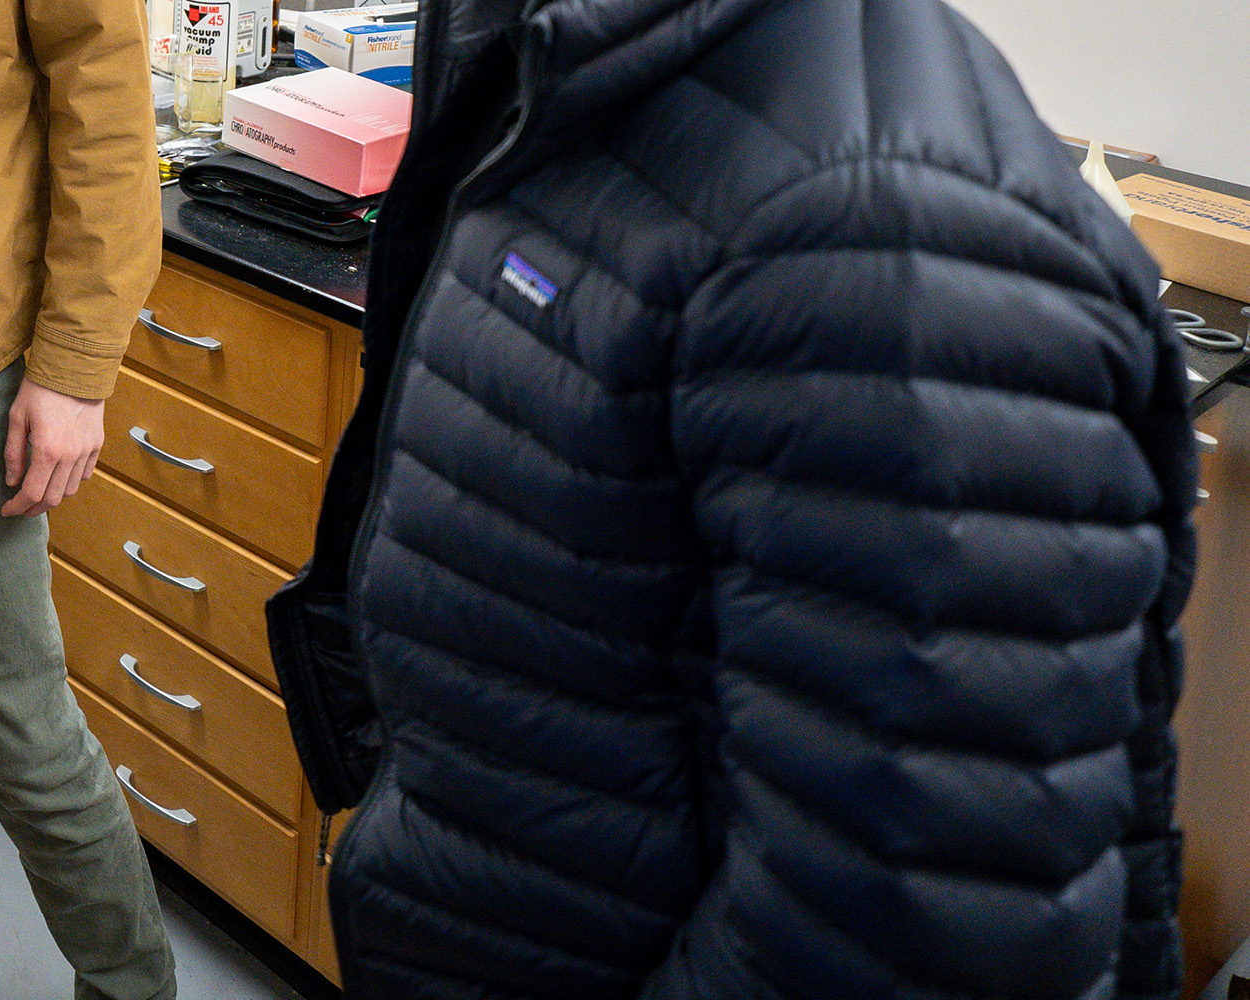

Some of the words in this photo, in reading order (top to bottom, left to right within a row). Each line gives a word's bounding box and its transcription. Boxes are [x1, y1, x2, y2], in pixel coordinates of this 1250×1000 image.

[207, 14, 224, 26] 45
[183, 26, 220, 37] vacuum
[367, 34, 402, 43] Fisherbrand
[369, 40, 400, 52] NITRILE
